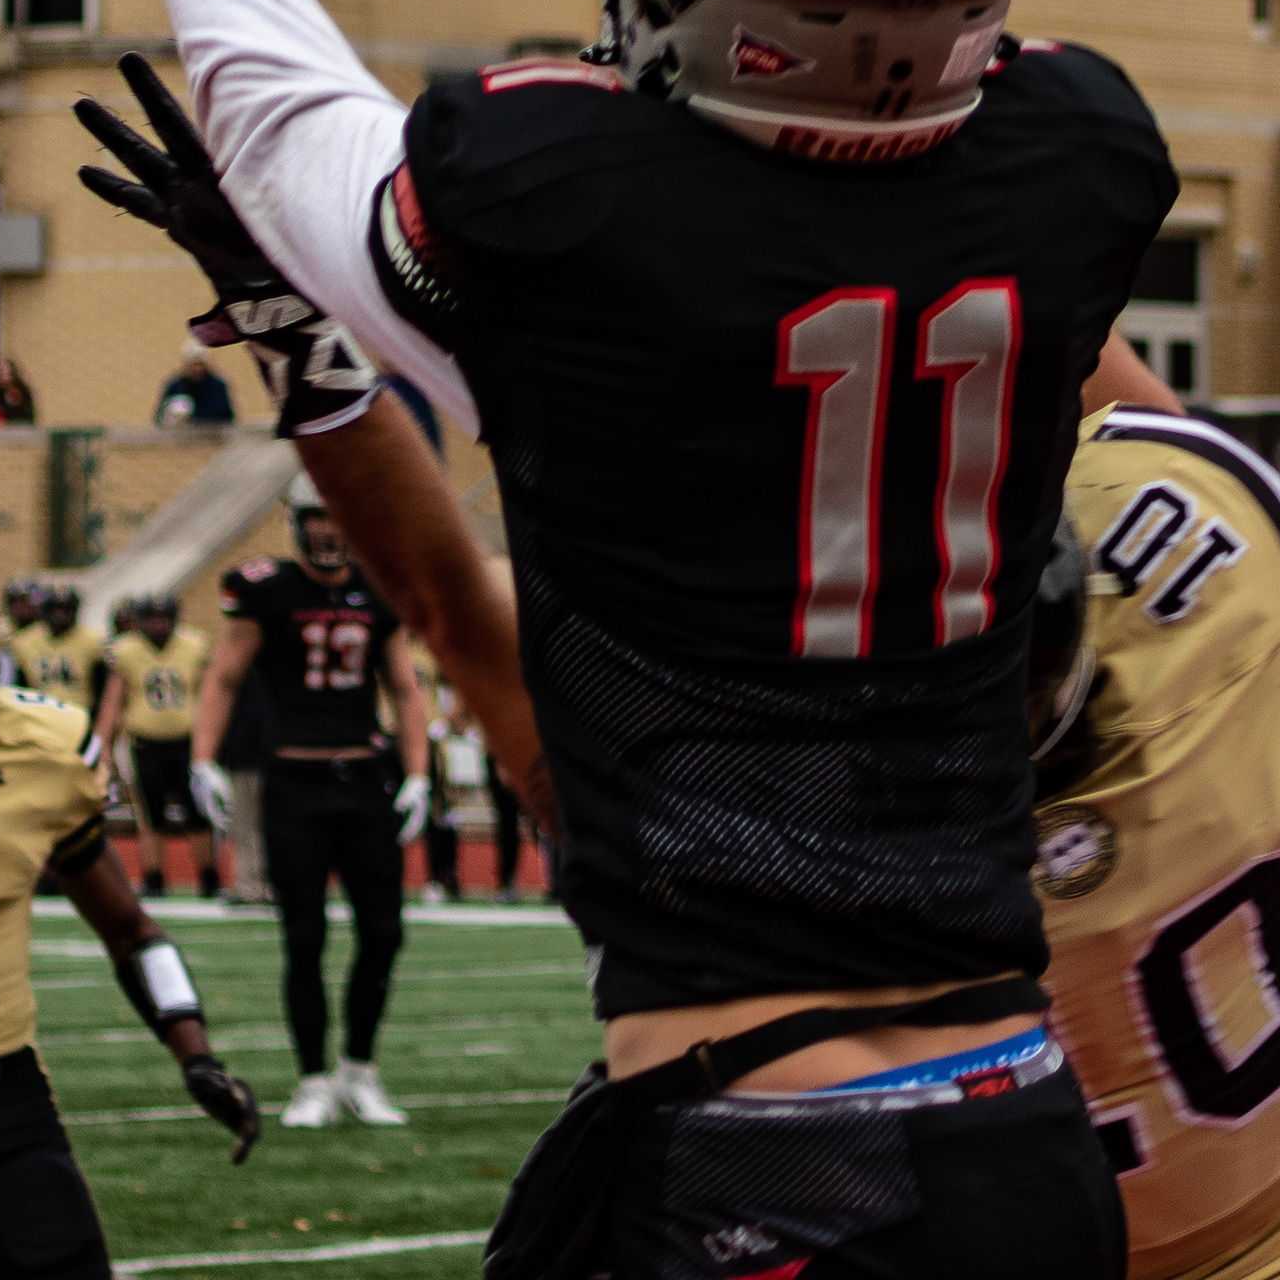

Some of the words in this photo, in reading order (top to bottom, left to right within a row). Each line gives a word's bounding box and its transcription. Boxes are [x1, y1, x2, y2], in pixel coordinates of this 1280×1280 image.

[771, 121, 956, 163] Riddell
[774, 276, 1024, 658] 11
[1090, 479, 1251, 626] 10
